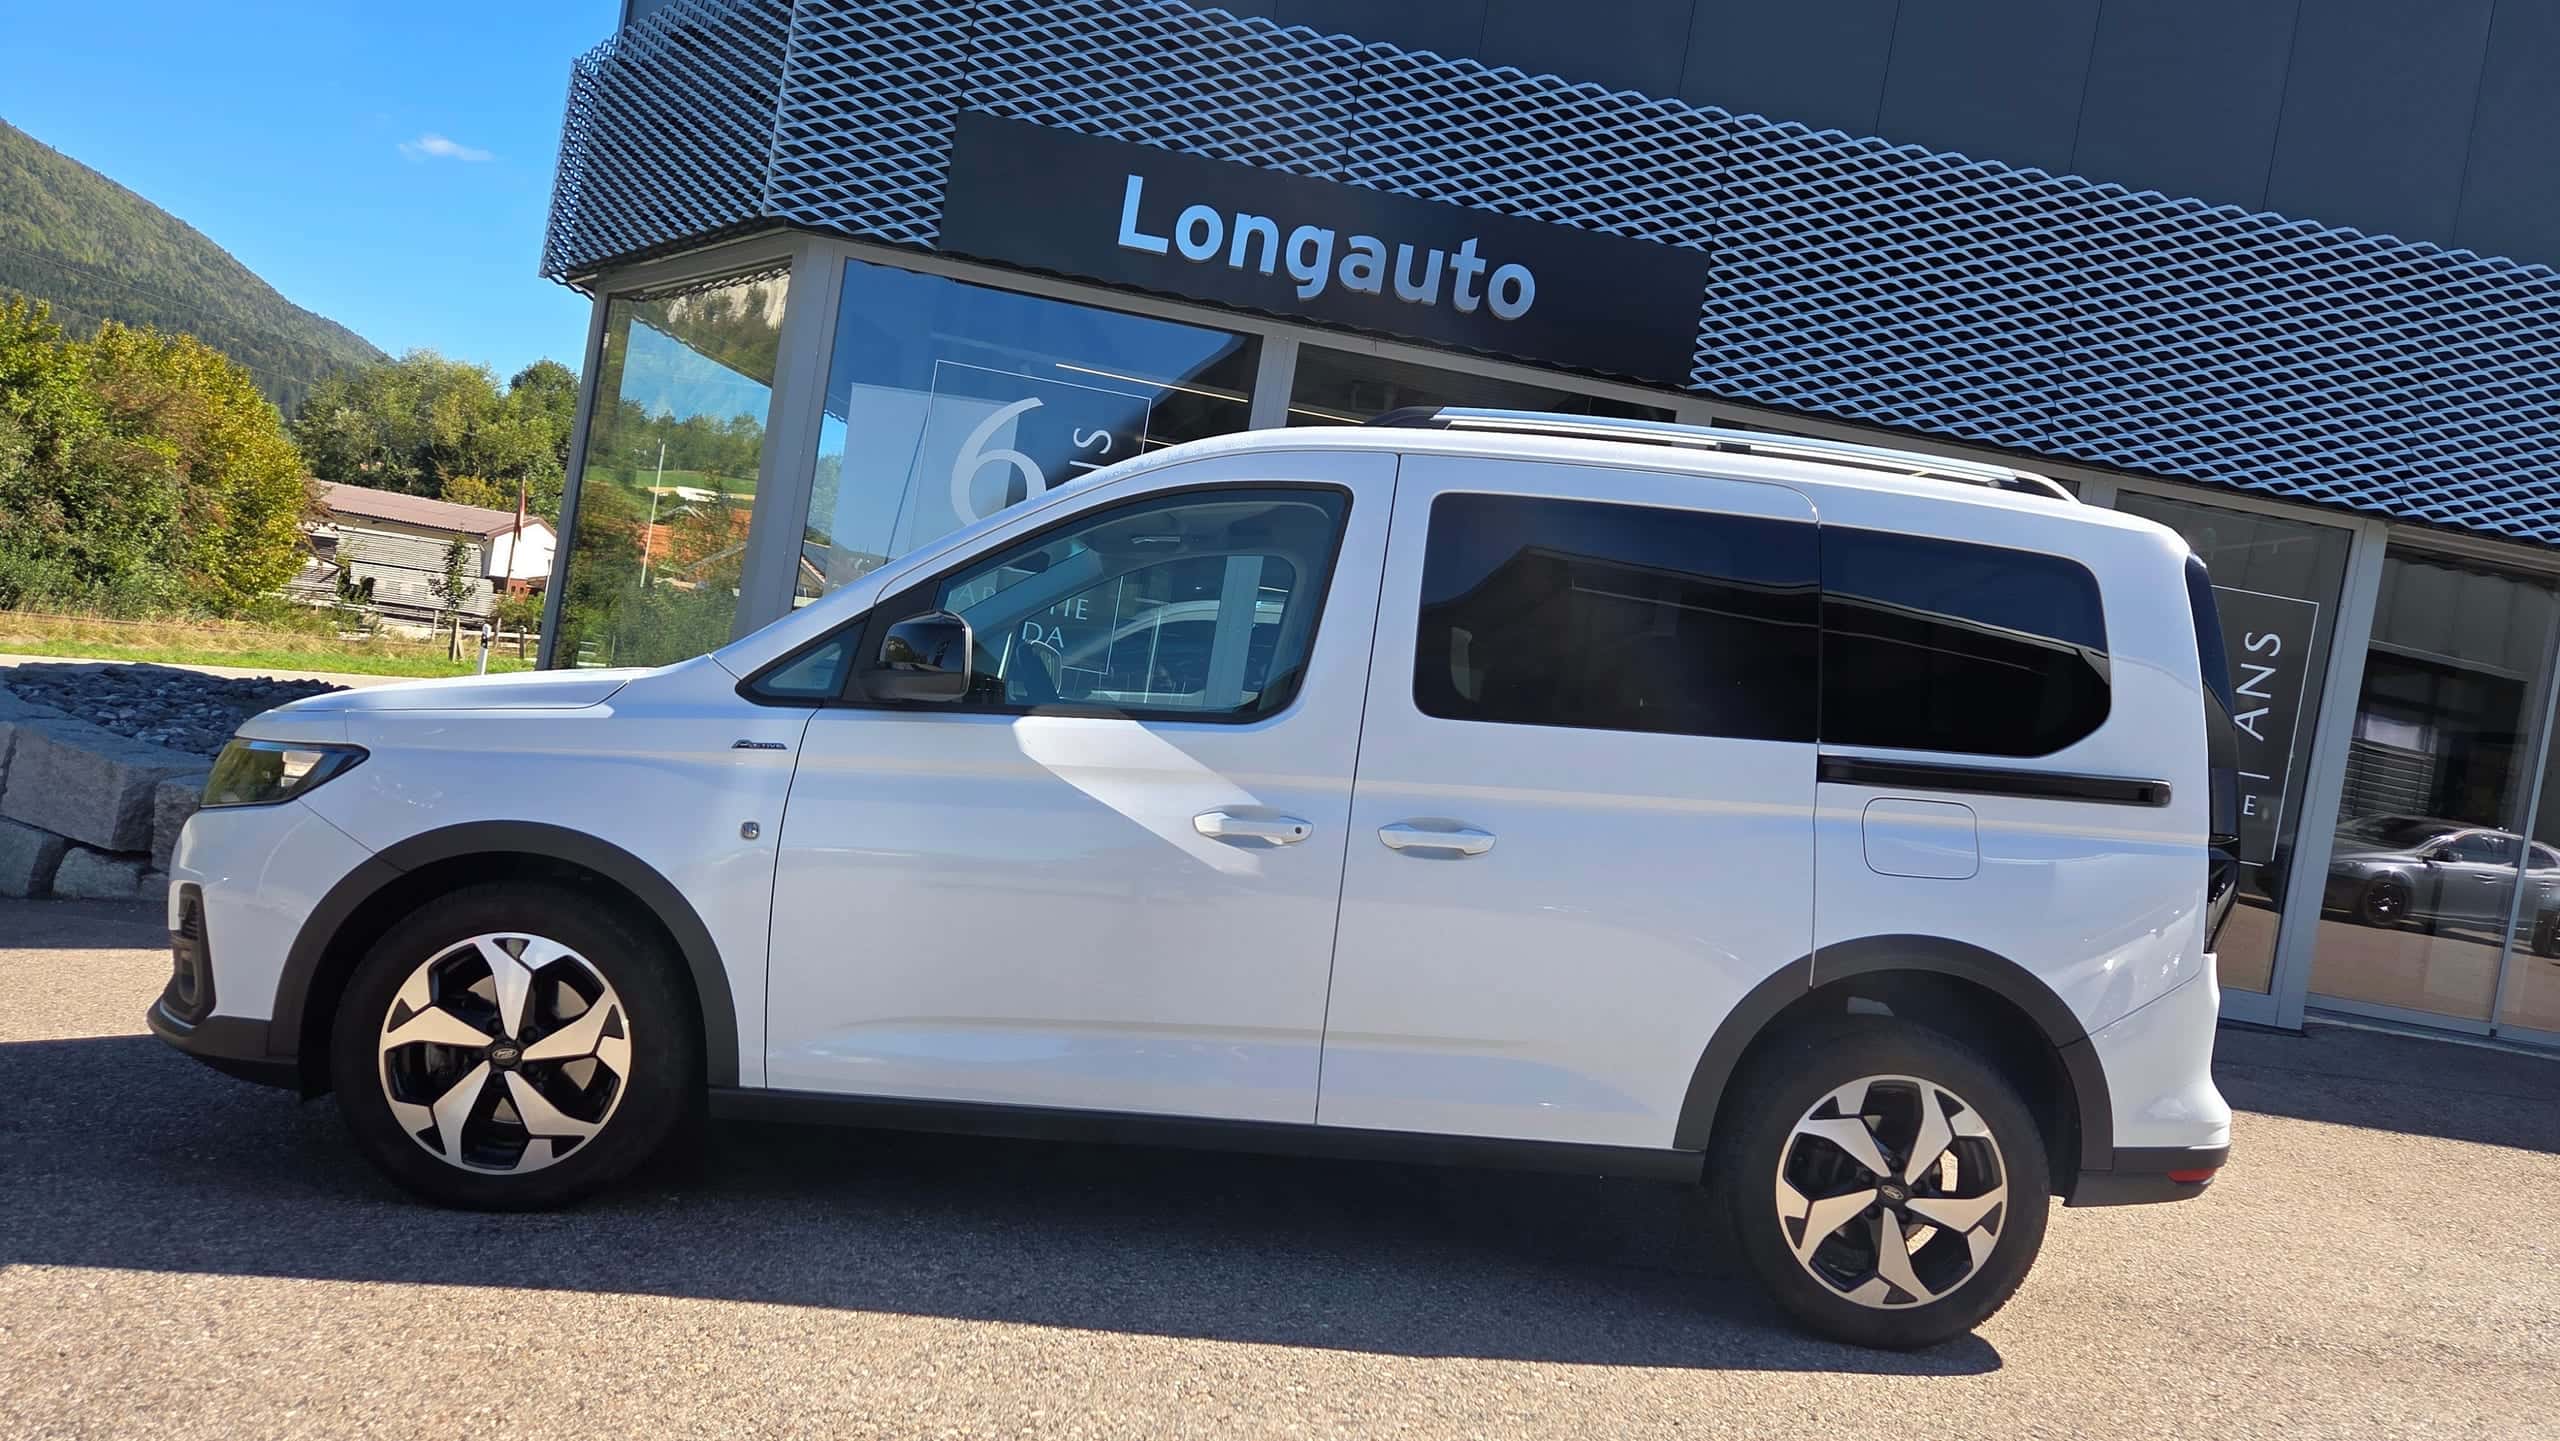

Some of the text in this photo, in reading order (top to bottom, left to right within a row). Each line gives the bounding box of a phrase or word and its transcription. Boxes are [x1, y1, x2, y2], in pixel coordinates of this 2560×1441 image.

[1117, 173, 1536, 321] Longauto
[951, 397, 1046, 527] 6
[2233, 631, 2282, 742] ANS
